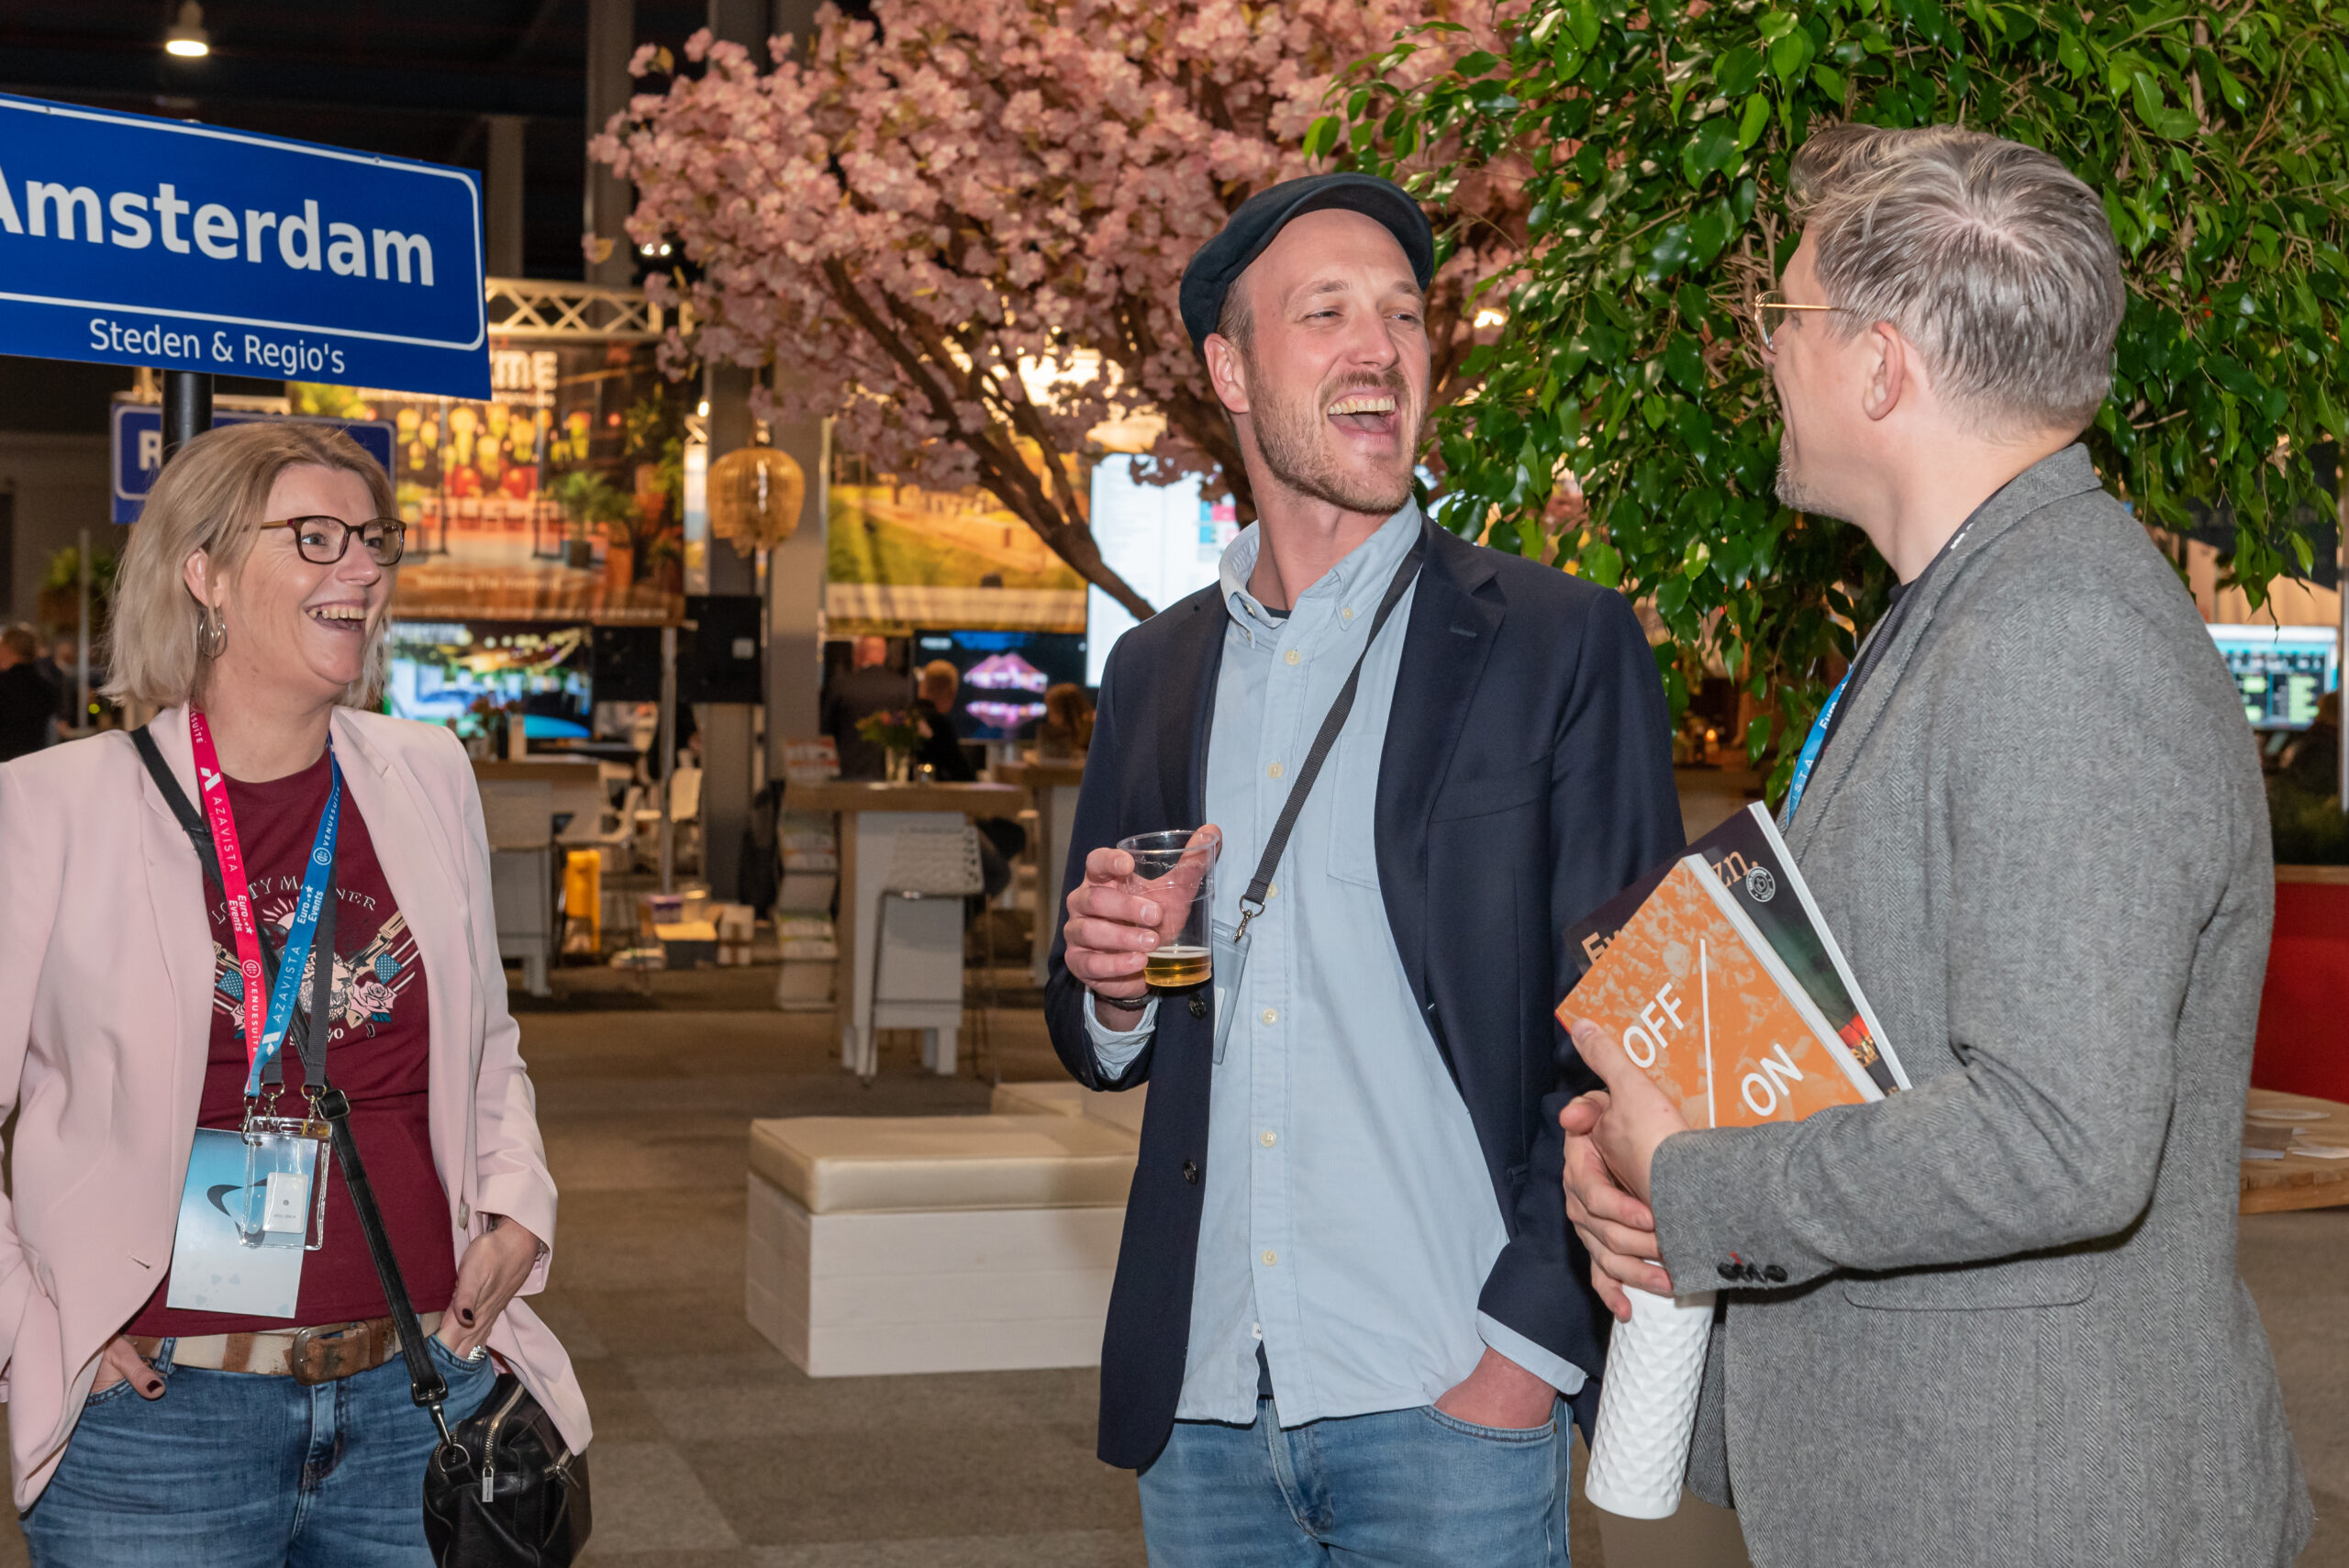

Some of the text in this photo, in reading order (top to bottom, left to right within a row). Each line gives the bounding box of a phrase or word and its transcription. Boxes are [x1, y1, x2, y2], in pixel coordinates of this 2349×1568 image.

[90, 318, 346, 375] Steden & Regio's
[212, 796, 239, 873] AZAVISTA
[228, 899, 243, 932] Events
[237, 895, 249, 917] Euro
[296, 903, 310, 925] Euro
[308, 891, 324, 922] Events
[273, 946, 302, 1024] AZAVISTA
[1622, 982, 1685, 1068] OFF
[1742, 1043, 1804, 1117] ON
